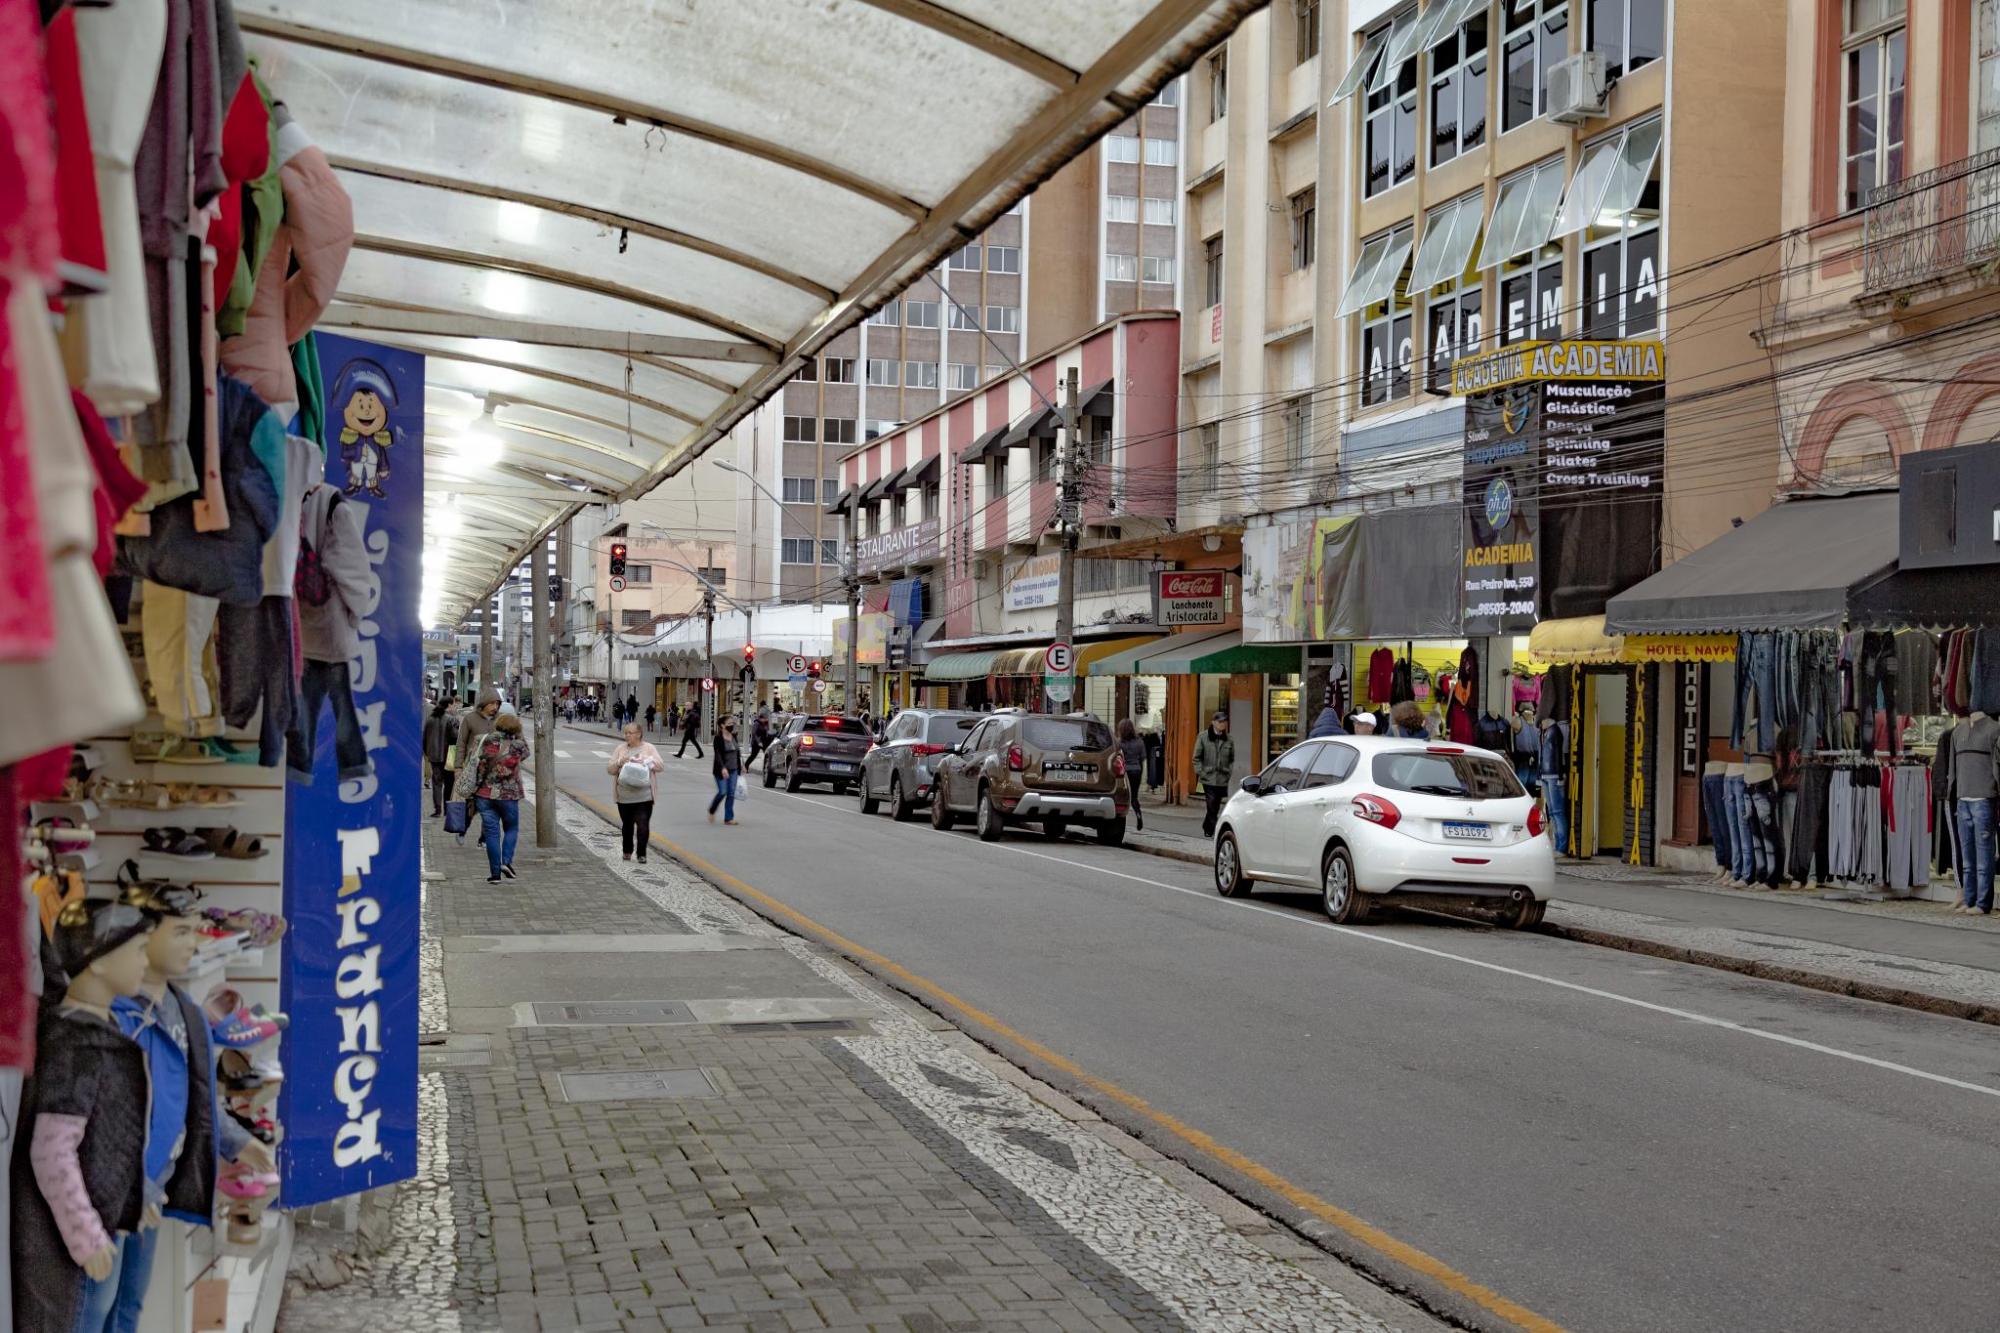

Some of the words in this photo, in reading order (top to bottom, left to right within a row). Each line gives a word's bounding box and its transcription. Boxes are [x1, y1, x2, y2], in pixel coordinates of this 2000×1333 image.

[1369, 257, 1658, 382] ACADEMIA
[1531, 344, 1661, 377] ACADEMIA
[1456, 346, 1524, 393] ACADEMIA
[1546, 383, 1632, 398] Musculação
[1546, 401, 1616, 416] Ginástica
[1467, 428, 1490, 443] Studio
[1546, 437, 1611, 452] Spinning
[1546, 455, 1598, 468] Pilates
[1546, 472, 1586, 486] Cross
[1589, 472, 1651, 487] Training
[1465, 542, 1534, 567] ACADEMIA
[1481, 578, 1503, 590] Pedro
[1171, 600, 1213, 610] Lanchonete
[1165, 610, 1218, 623] Aristocrata
[1055, 650, 1065, 665] E
[1646, 644, 1689, 656] HOTEL
[795, 659, 801, 668] E
[1683, 662, 1698, 772] HOTEL
[1631, 664, 1645, 865] CADEMIA
[333, 826, 384, 1169] França
